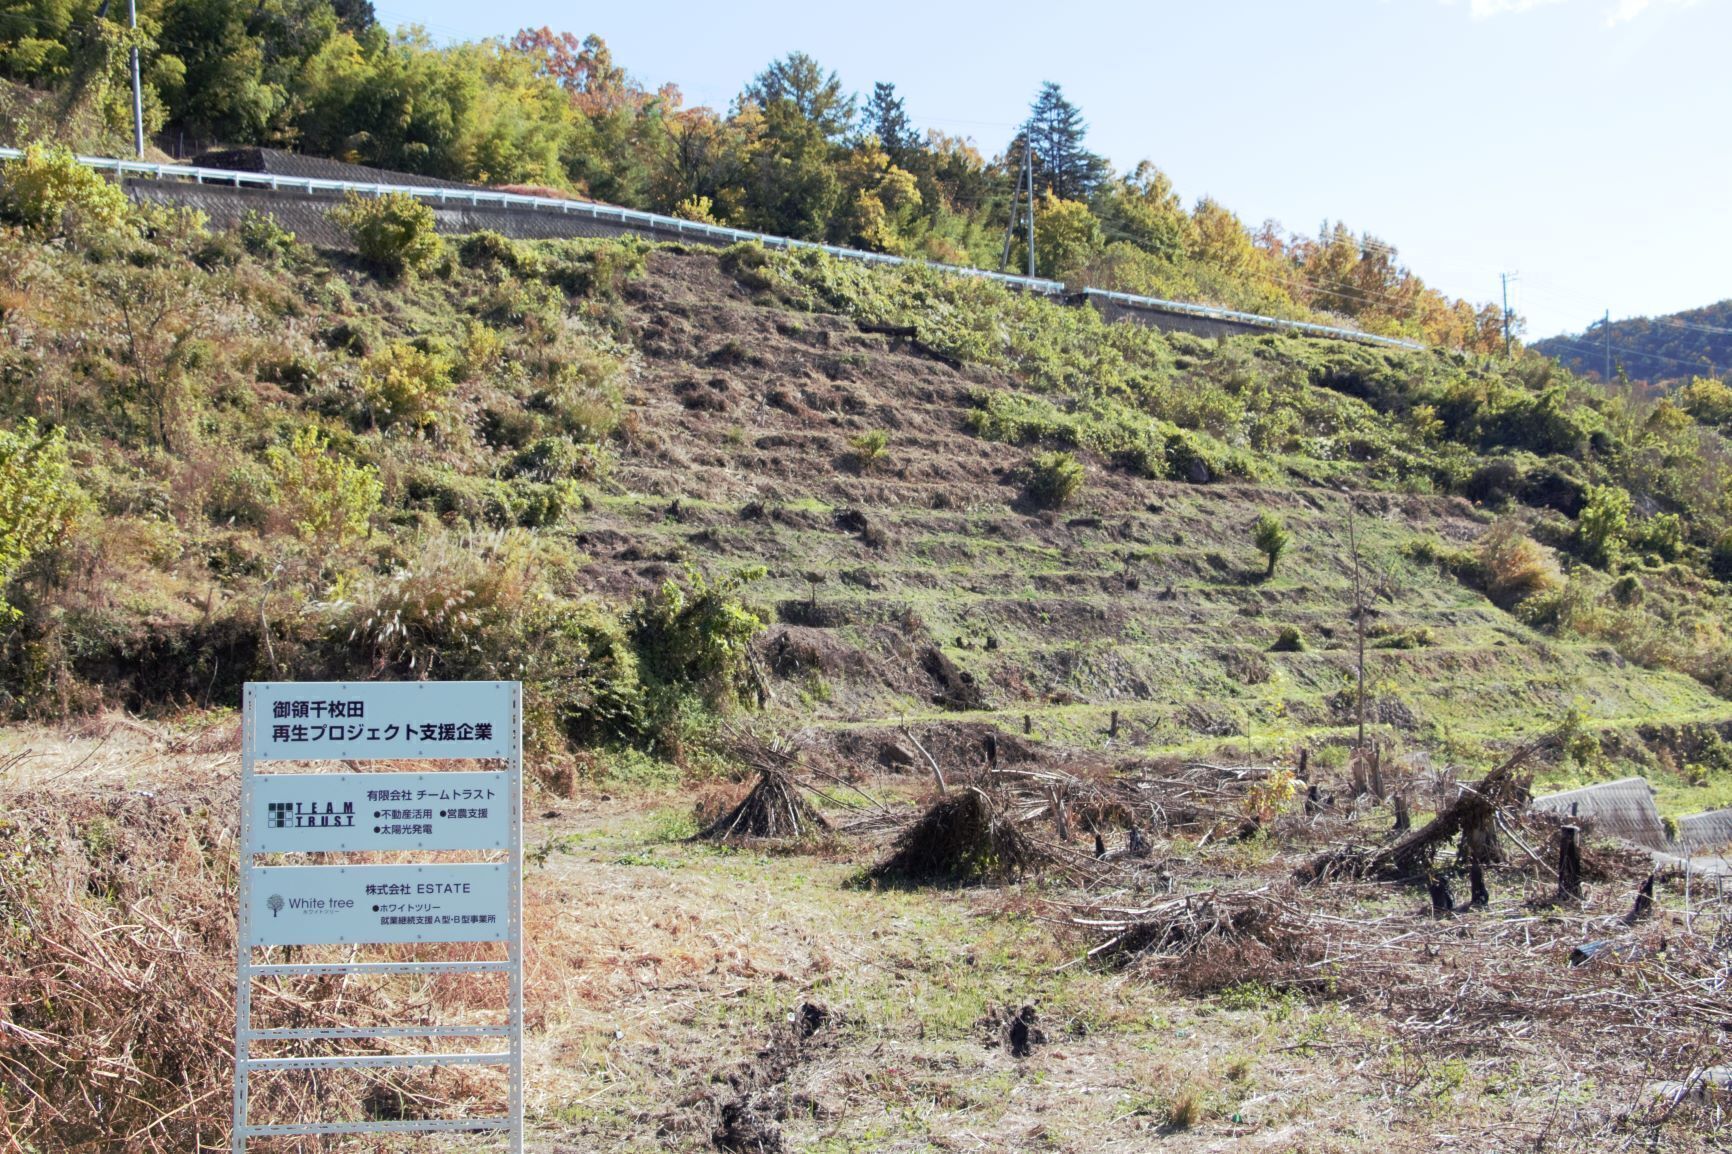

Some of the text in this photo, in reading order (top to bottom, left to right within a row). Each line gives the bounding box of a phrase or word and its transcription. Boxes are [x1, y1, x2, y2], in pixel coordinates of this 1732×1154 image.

[272, 700, 364, 718] 御領千枚田
[272, 723, 493, 742] 再生プロジェクト支援企業
[367, 789, 495, 801] 有限会社 チームトラスト
[296, 802, 354, 814] TEAM
[296, 815, 354, 827] TRUST
[365, 883, 471, 896] 株式会社 ESTATE
[289, 897, 354, 909] White tree
